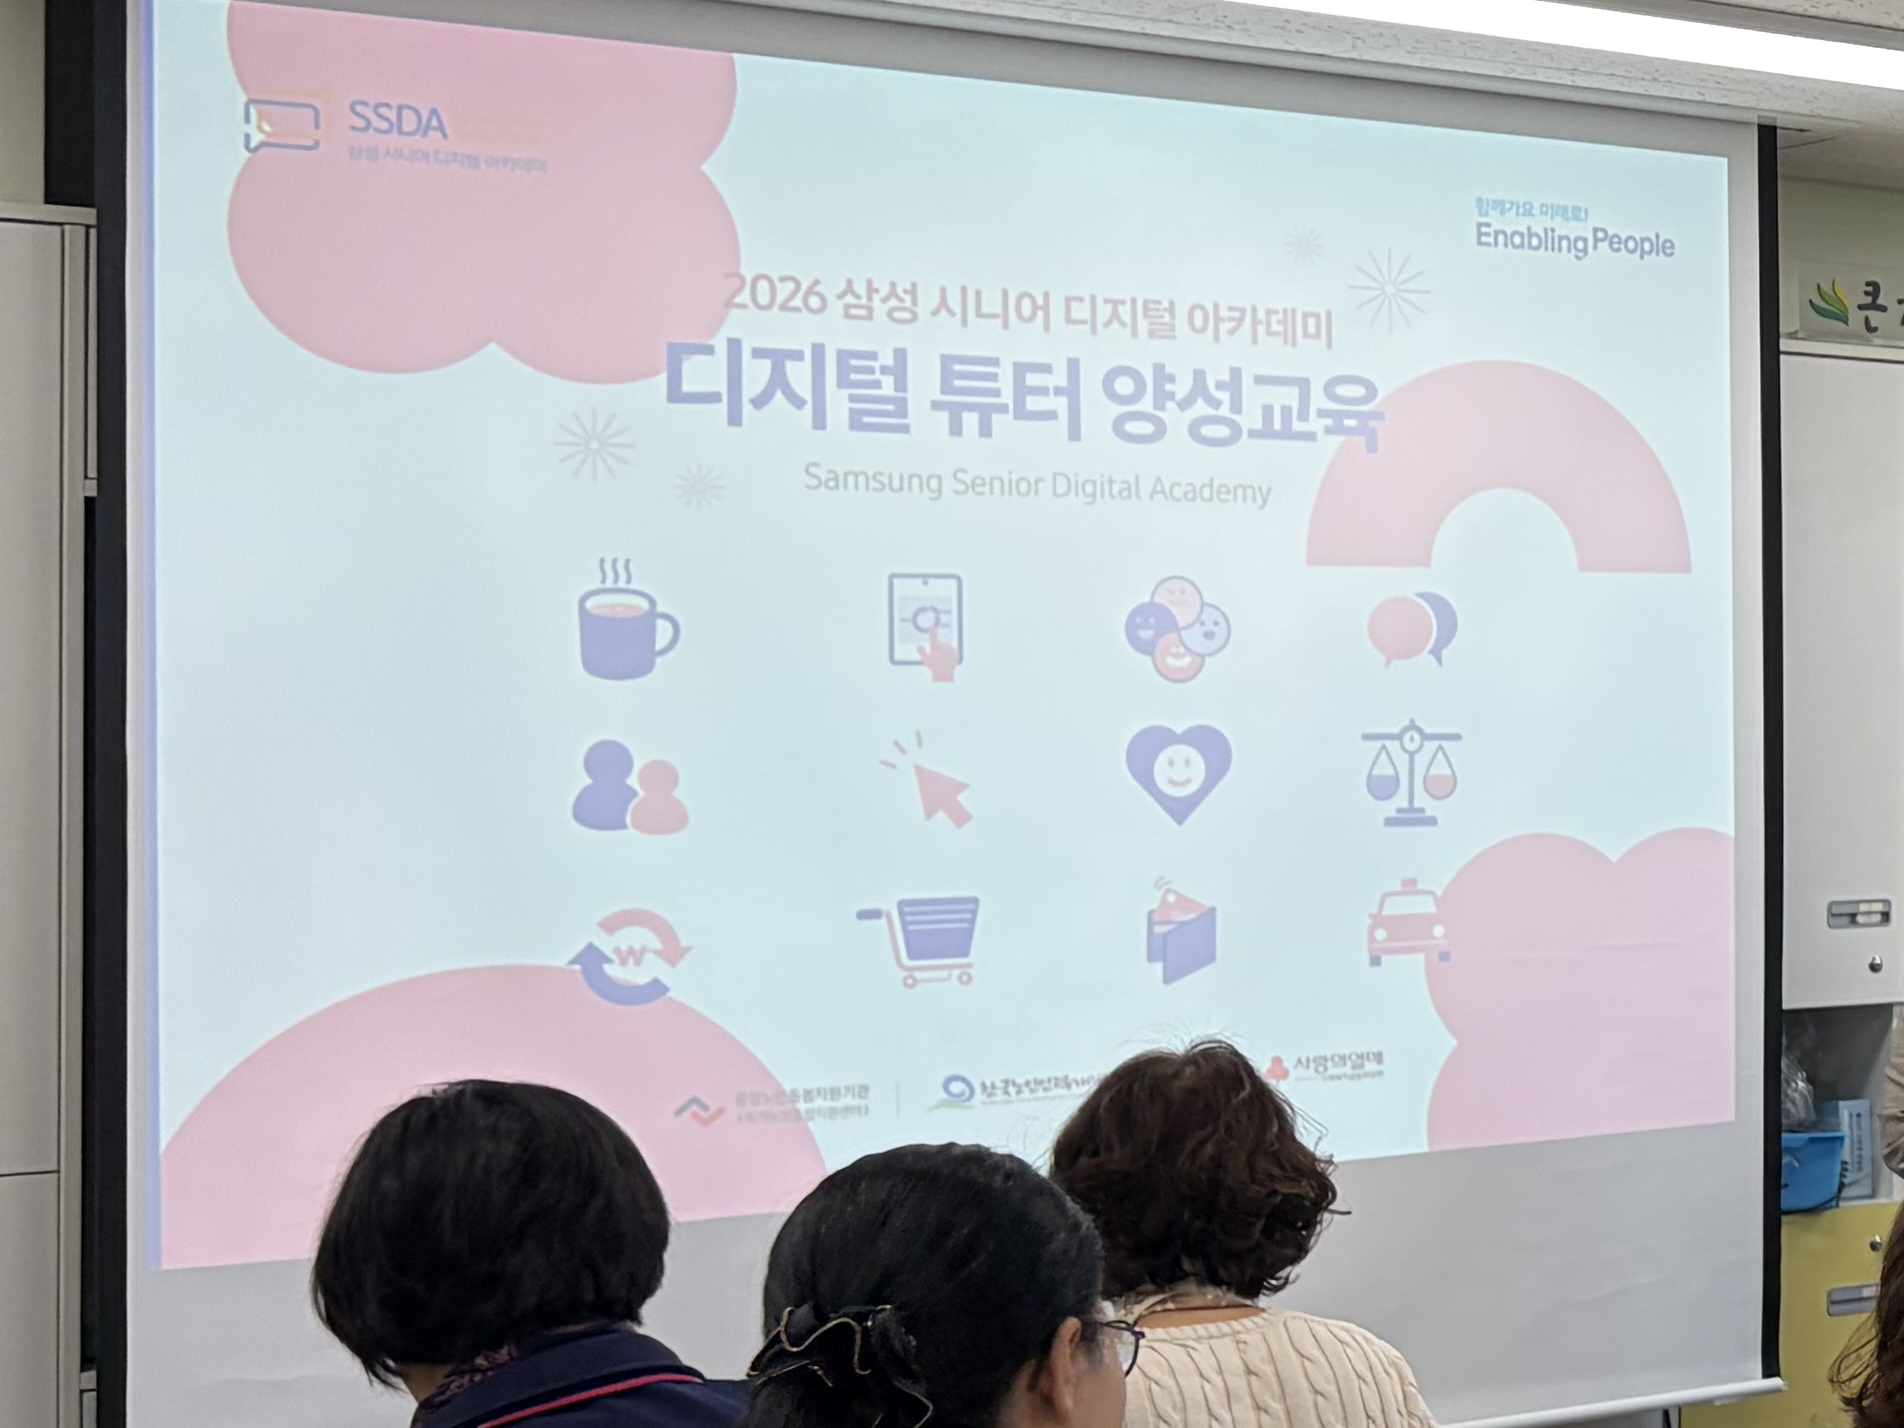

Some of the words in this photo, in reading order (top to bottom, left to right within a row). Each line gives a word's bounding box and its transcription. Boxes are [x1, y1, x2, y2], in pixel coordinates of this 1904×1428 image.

[349, 100, 449, 140] SSDA
[433, 150, 481, 170] 디지털
[1475, 221, 1589, 261] Enabling
[1592, 226, 1676, 260] People
[722, 271, 828, 315] 2026
[836, 277, 919, 325] 삼성
[930, 284, 1051, 333] 시니어
[1063, 293, 1178, 340] 디지털
[1187, 301, 1333, 351] 아카데미
[1857, 280, 1888, 334] 큰
[666, 337, 911, 434] 디지털
[930, 352, 1082, 443] 튜터
[1101, 360, 1386, 454] 양성교육
[804, 461, 944, 502] Samsung
[951, 468, 1045, 498] Senior
[1052, 471, 1141, 506] Digital
[1149, 475, 1273, 511] Academy
[1293, 1050, 1384, 1075] 사랑의열매
